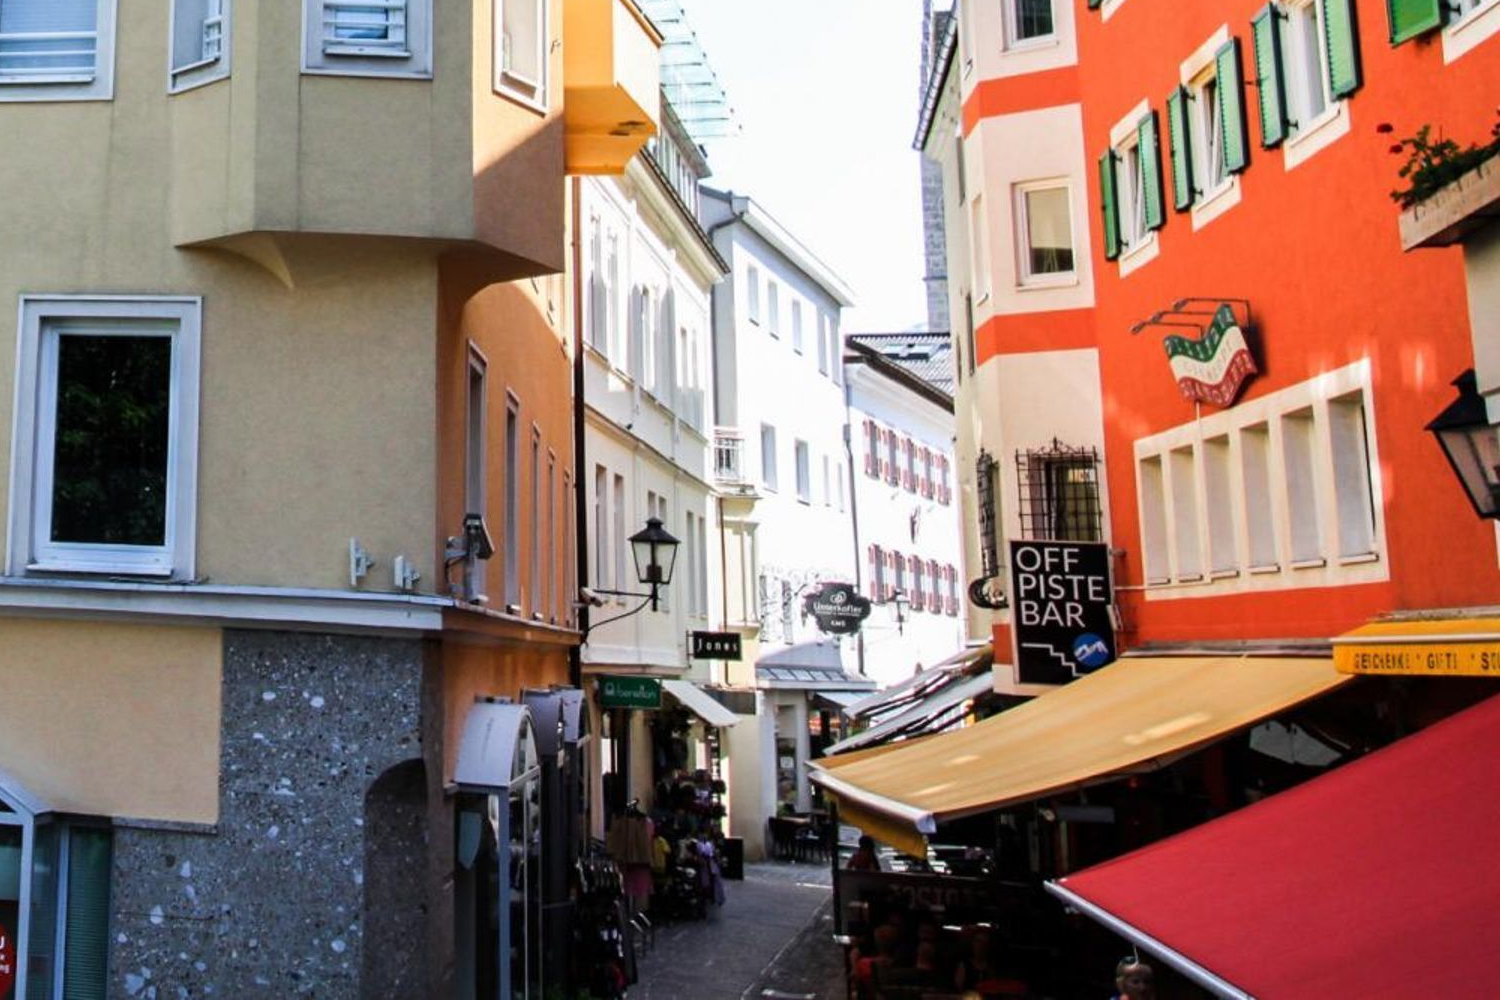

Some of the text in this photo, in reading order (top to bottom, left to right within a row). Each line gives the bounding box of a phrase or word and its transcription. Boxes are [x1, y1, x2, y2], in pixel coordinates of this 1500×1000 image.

[1016, 546, 1080, 573] OFF
[1018, 573, 1106, 602] PISTE
[1020, 600, 1086, 628] BAR
[697, 637, 738, 653] Jones
